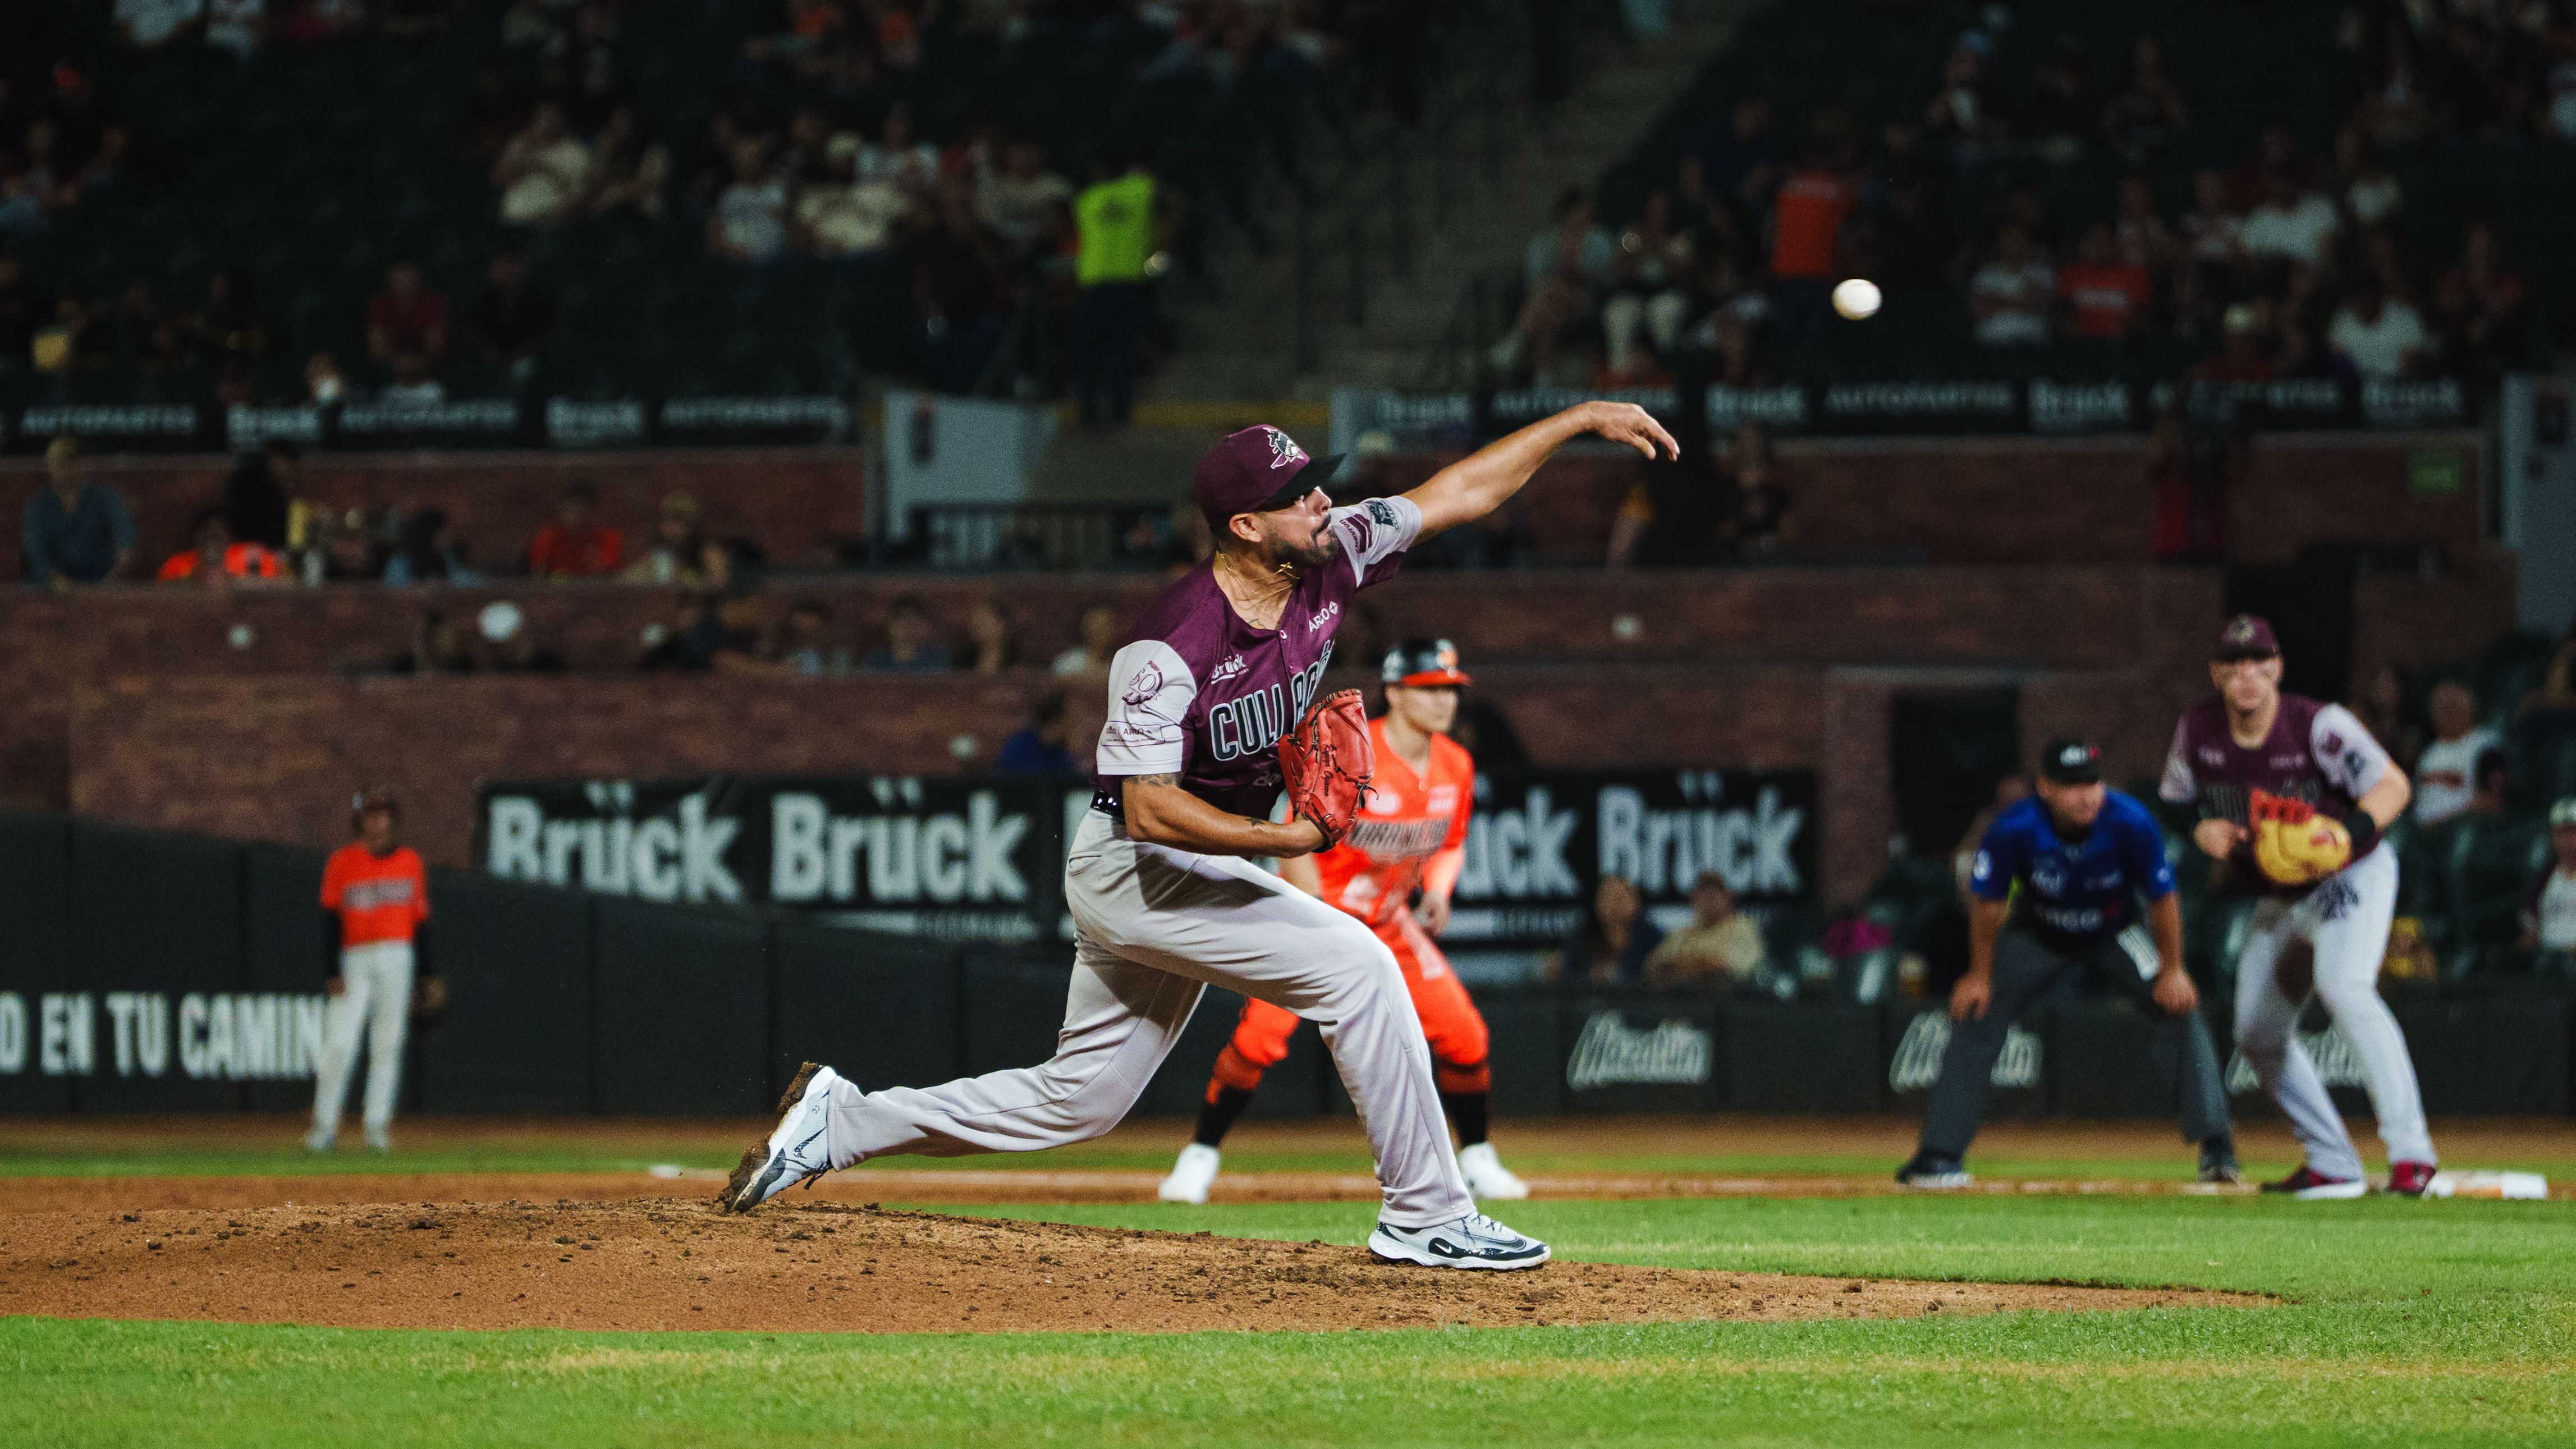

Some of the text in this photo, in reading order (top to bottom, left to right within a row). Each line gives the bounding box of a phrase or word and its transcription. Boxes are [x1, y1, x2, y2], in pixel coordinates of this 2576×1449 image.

[1308, 608, 1331, 632] ARO
[1209, 639, 1335, 762] CULIAC
[771, 778, 1031, 901] Brück
[1455, 772, 1580, 897] ück
[1596, 769, 1804, 895] Brück
[41, 992, 94, 1075] EN
[105, 992, 168, 1077] TU
[178, 993, 327, 1079] CAMIN
